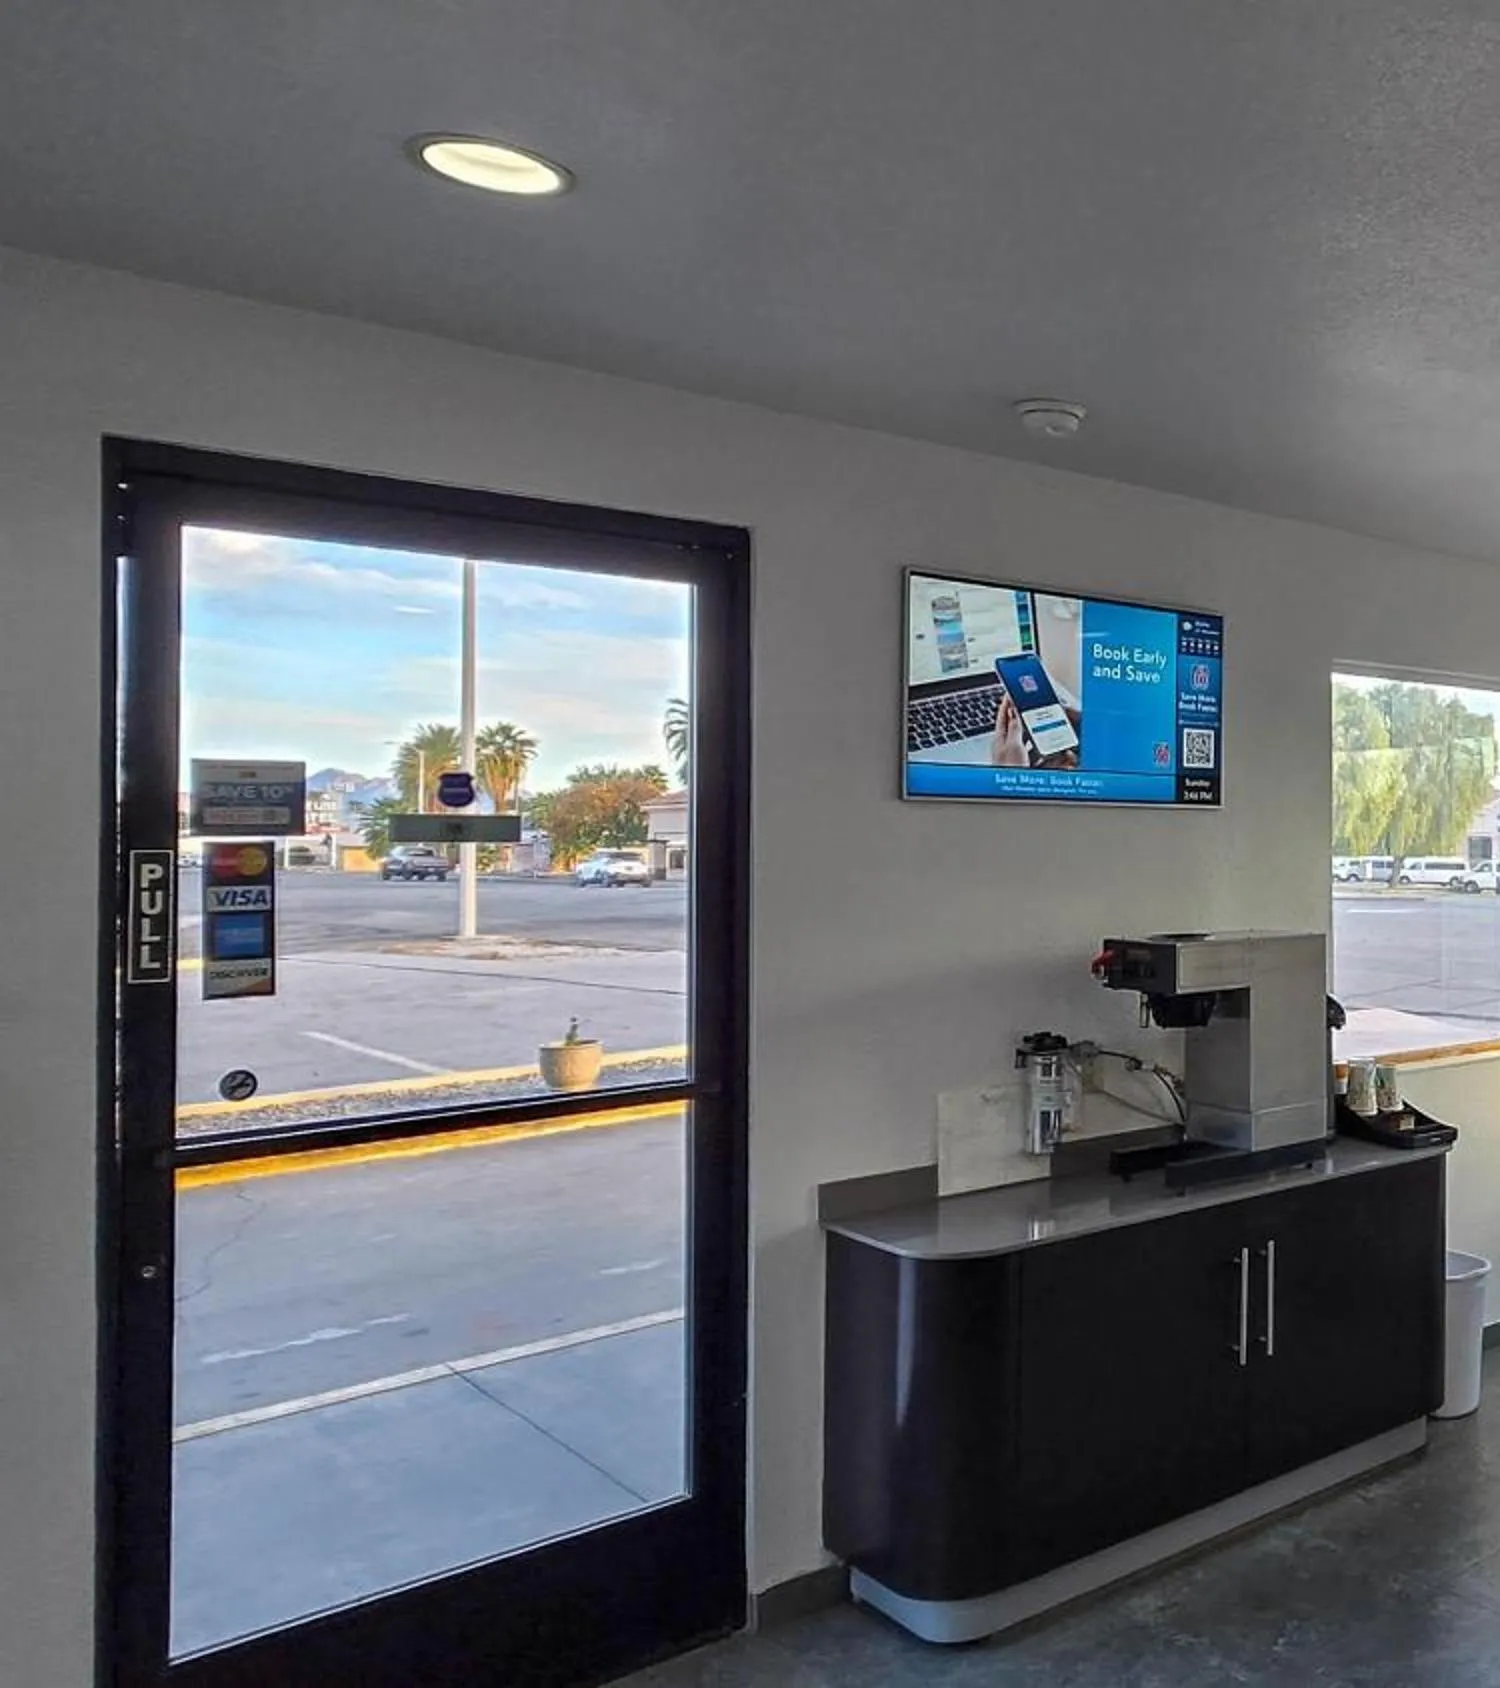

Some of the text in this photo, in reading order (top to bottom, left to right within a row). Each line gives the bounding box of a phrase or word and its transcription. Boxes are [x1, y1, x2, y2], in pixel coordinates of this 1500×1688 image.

[1093, 643, 1167, 669] Book Early
[1092, 664, 1161, 684] and Save
[202, 784, 258, 799] SAVE
[209, 888, 269, 907] VISA
[139, 863, 164, 970] PULL
[209, 967, 268, 980] DISCOVER
